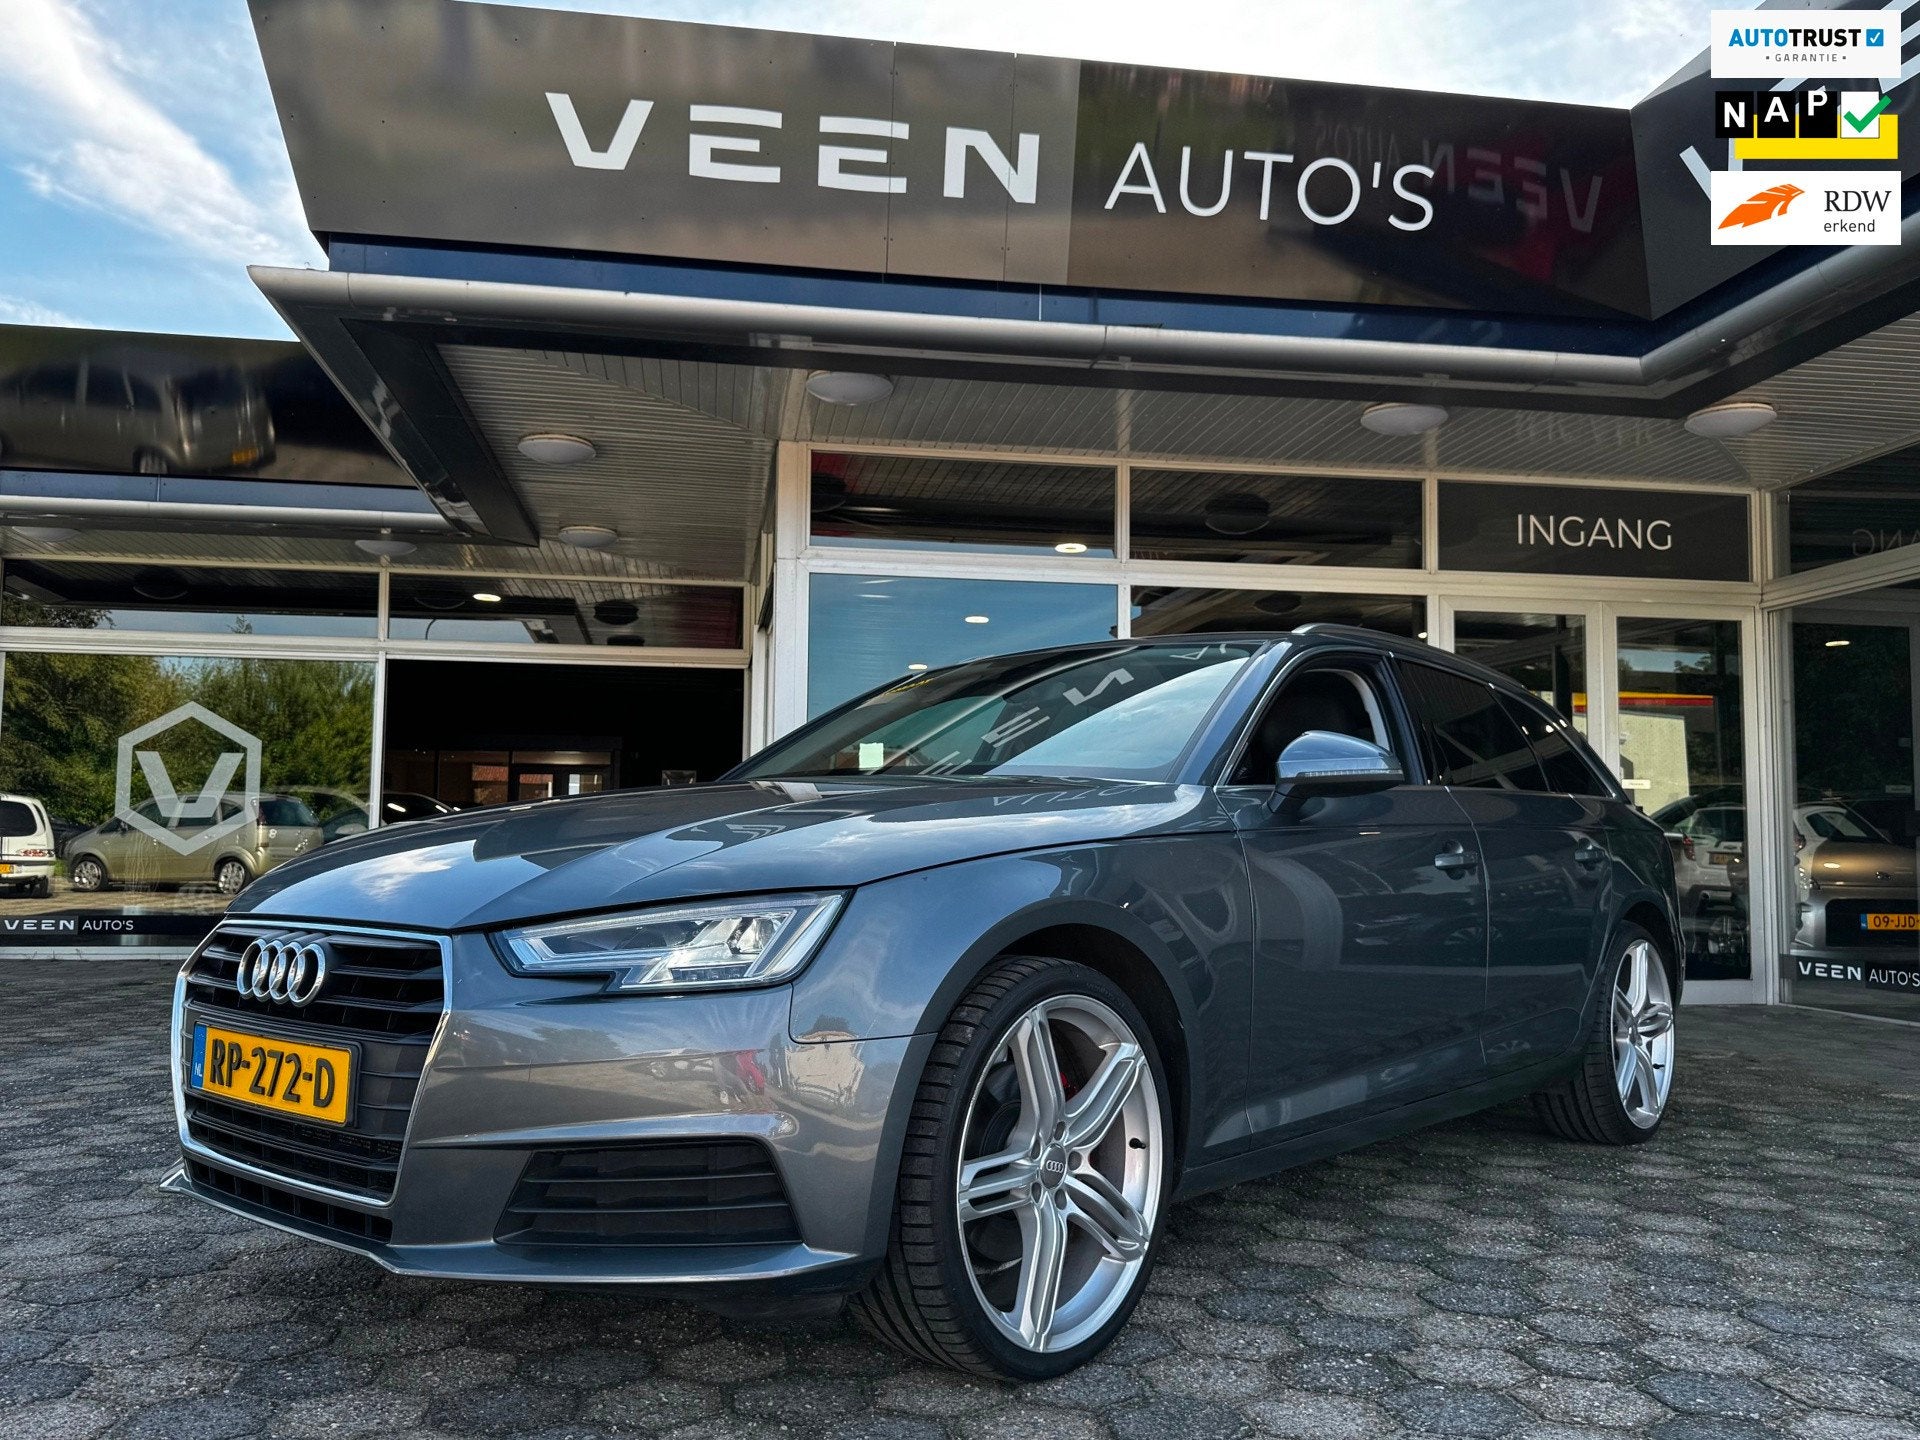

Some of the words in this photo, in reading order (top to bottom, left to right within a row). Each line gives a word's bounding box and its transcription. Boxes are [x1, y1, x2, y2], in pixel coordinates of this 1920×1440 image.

[545, 92, 1039, 204] VEEN
[1104, 142, 1435, 231] AUTO'S
[1517, 514, 1672, 550] INGANG
[136, 751, 244, 818] V
[4, 920, 75, 930] VEEN
[82, 920, 134, 931] AUTO'S
[1799, 961, 1862, 980] VEEN
[1869, 968, 1920, 987] AUTO'S
[210, 1038, 335, 1108] RP-272-D
